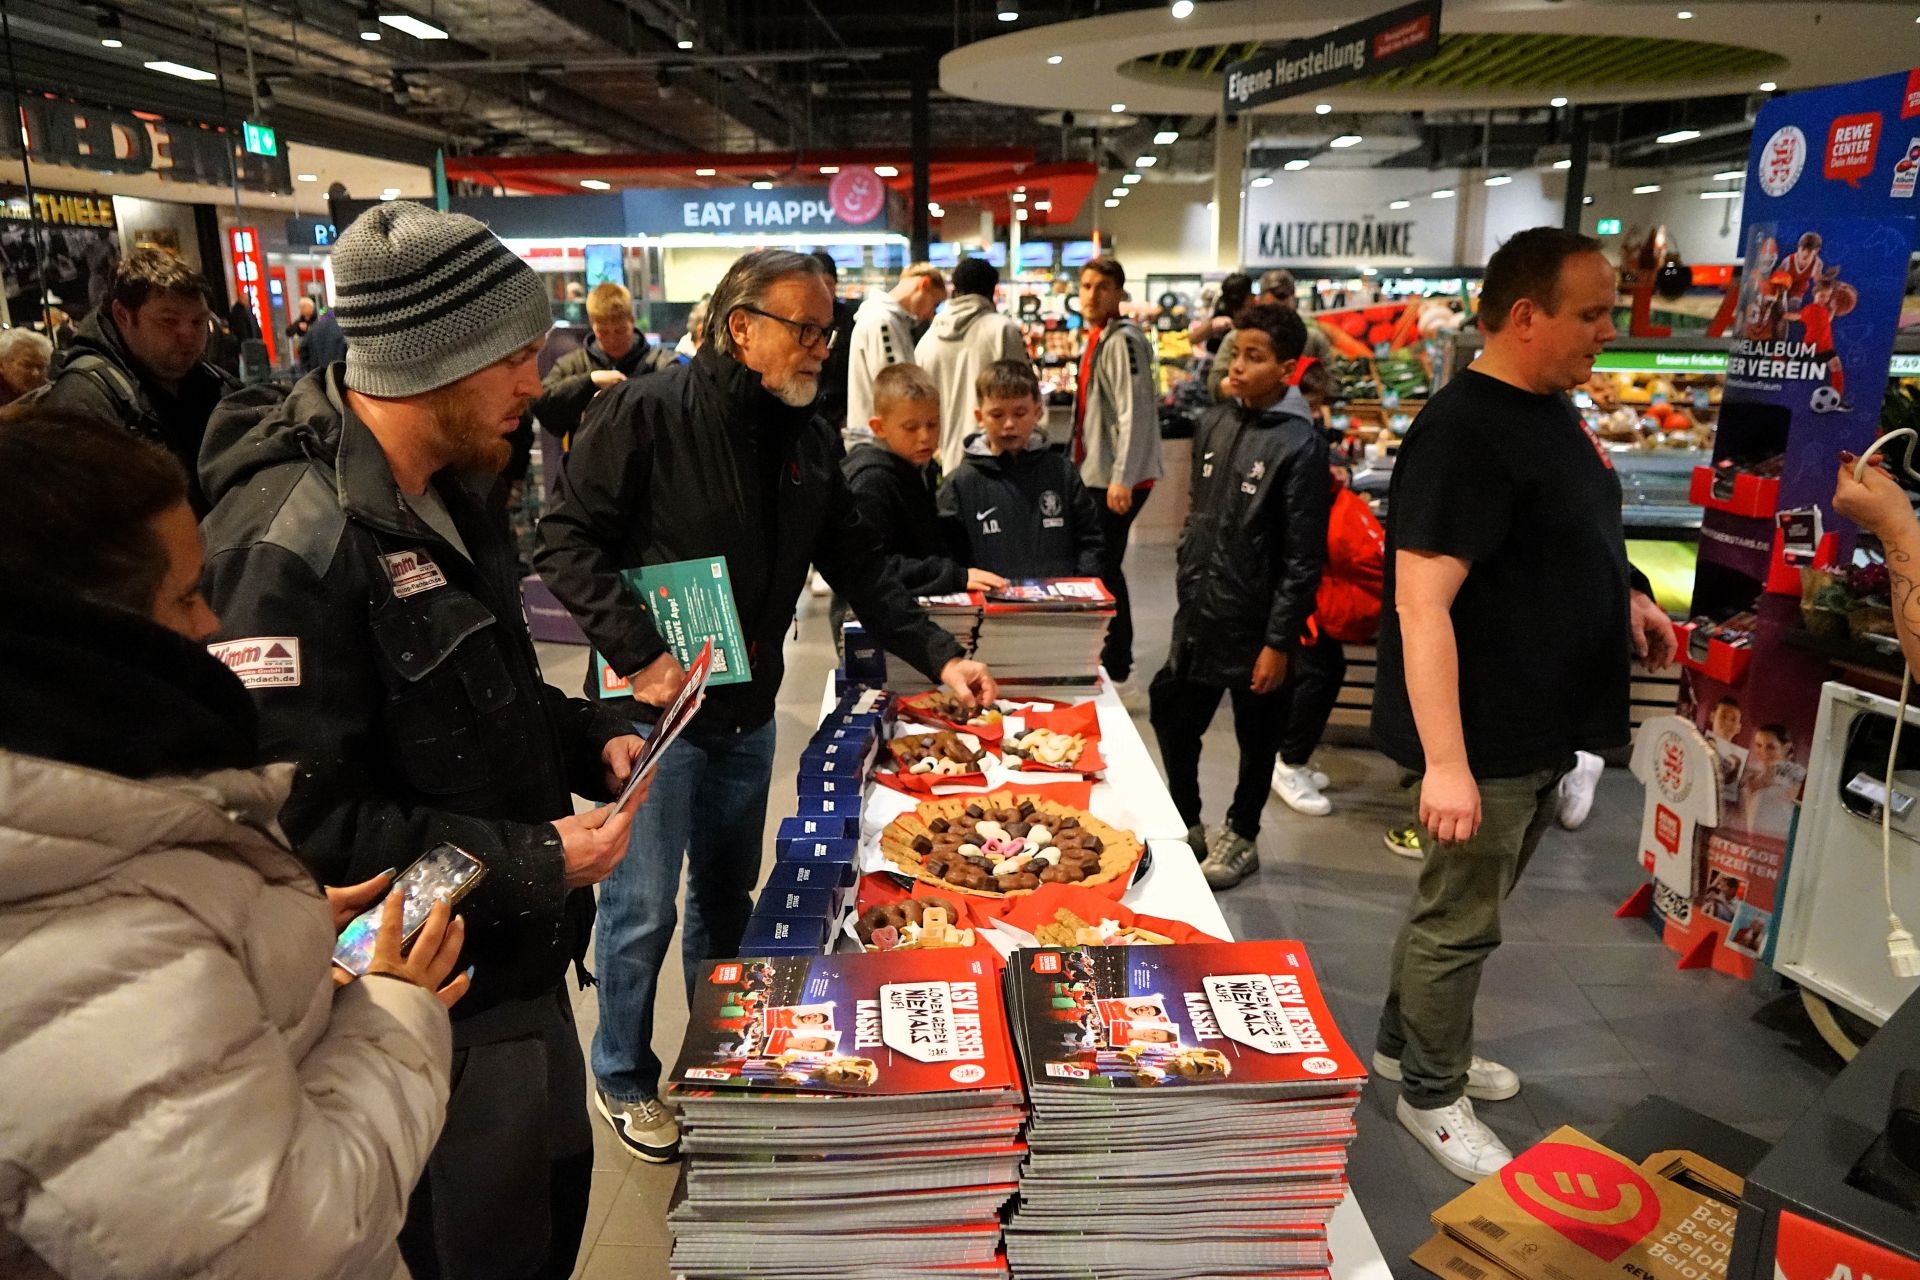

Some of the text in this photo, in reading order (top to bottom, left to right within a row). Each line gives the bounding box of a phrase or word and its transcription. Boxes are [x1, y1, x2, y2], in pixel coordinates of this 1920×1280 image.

[1228, 39, 1367, 102] Eigene Herstellung
[1834, 122, 1873, 143] REWE
[1832, 140, 1870, 157] CENTER
[34, 192, 114, 228] THIELE
[683, 201, 736, 227] EAT
[744, 200, 836, 226] HAPPY
[1258, 213, 1416, 258] KALTGETRÄNKE
[1748, 358, 1827, 381] VEREIN
[667, 598, 680, 619] App!
[664, 619, 675, 644] Euros
[672, 620, 686, 647] REWE
[680, 647, 690, 663] der
[774, 922, 783, 939] STICKER
[781, 924, 789, 938] STARS
[890, 990, 905, 1010] AUF!
[1213, 982, 1232, 1003] AUF!
[855, 999, 883, 1050] KASSEL
[950, 981, 985, 1060] KSV HESSEN
[1183, 992, 1224, 1042] KASSEL
[1270, 975, 1330, 1053] KSV HESSEN
[1676, 1218, 1731, 1256] Belo
